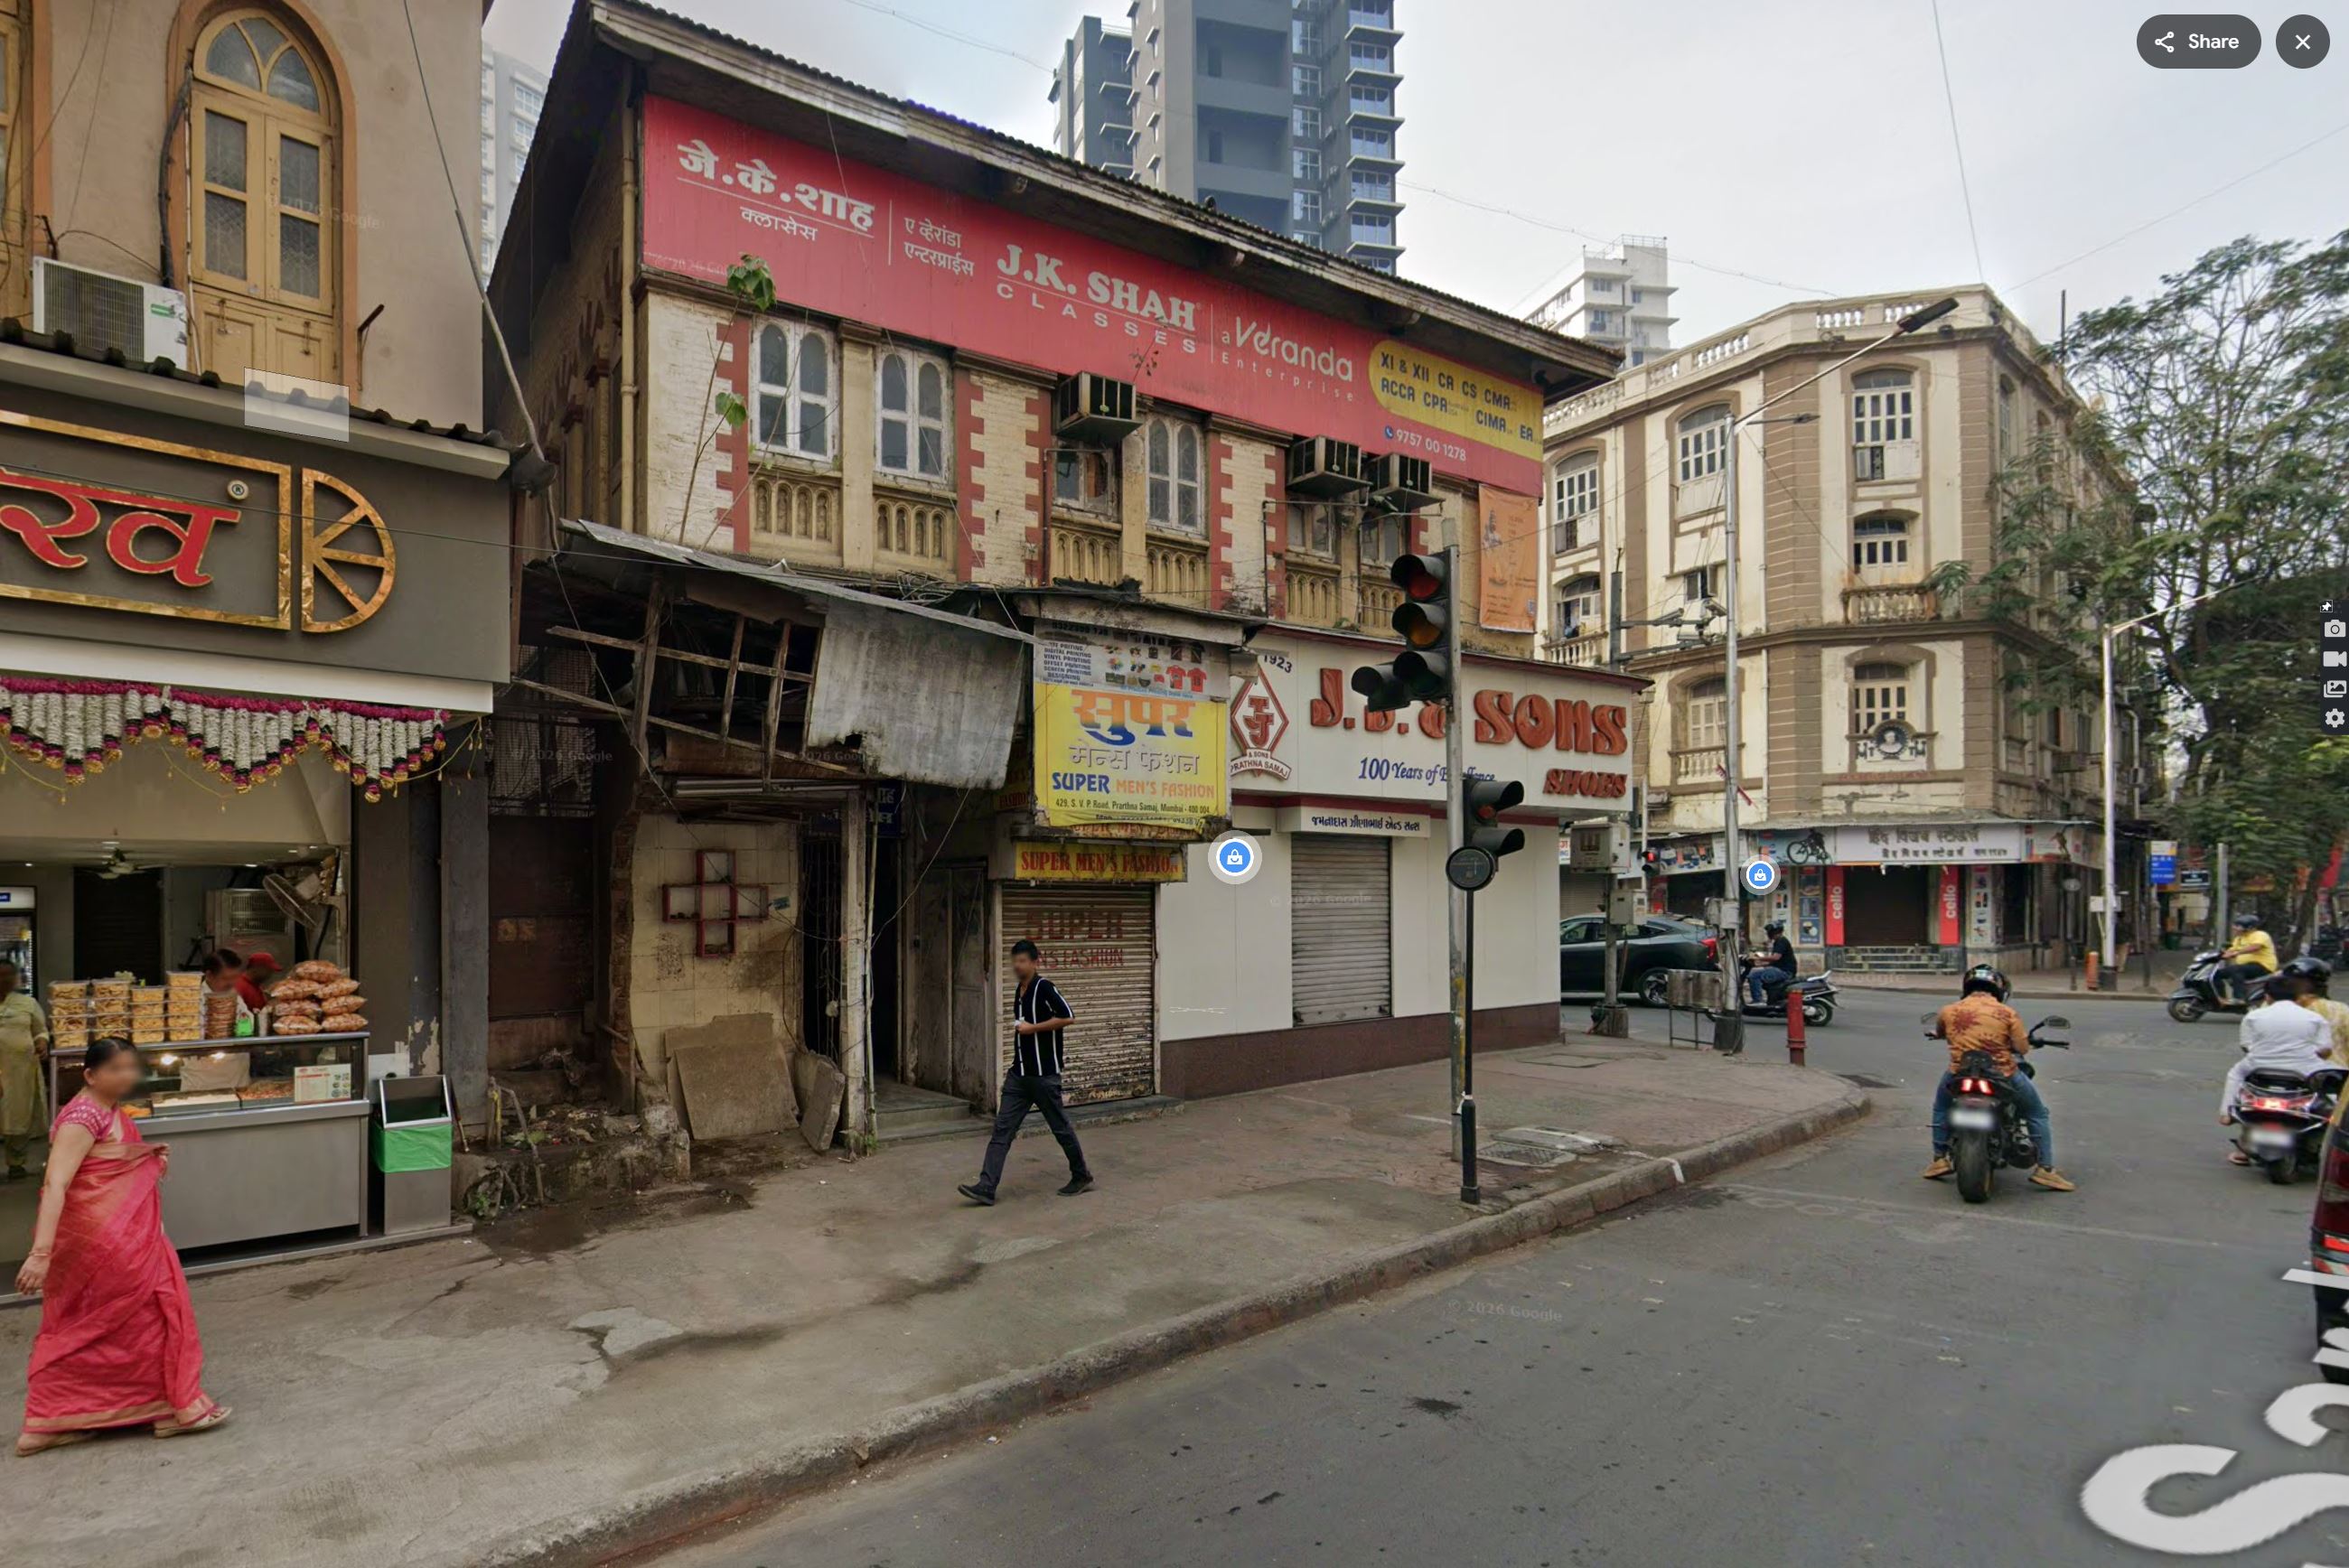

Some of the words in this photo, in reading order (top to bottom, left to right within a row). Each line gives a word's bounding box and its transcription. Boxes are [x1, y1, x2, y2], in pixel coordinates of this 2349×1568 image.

[740, 206, 818, 241] क्लासेस
[904, 217, 915, 234] ए
[997, 244, 1077, 294] J.K.
[1087, 271, 1195, 331] SHAH
[997, 283, 1195, 353] CLASSES
[1222, 329, 1230, 344] a
[1235, 316, 1353, 382] Veranda
[1222, 352, 1353, 402] Enterprise
[1380, 352, 1394, 370] XI
[1399, 359, 1407, 373] &
[1412, 363, 1429, 383] XII
[1462, 381, 1477, 398] CS
[1396, 429, 1422, 447] 9757
[1425, 438, 1440, 453] 00
[1443, 443, 1466, 462] 1278
[1063, 656, 1091, 664] PRINTING
[1066, 649, 1091, 658] PRINTING
[1072, 689, 1196, 746] सुपर
[1052, 771, 1110, 794] SUPER
[1116, 779, 1156, 796] MEN'S
[1162, 782, 1214, 798] FASHION
[1264, 761, 1288, 777] SAMAJ
[1358, 757, 1390, 780] 100
[1391, 761, 1423, 780] Years
[1426, 764, 1440, 786] of
[1543, 768, 1628, 798] SHOES
[1160, 803, 1184, 812] Mumbai
[1021, 851, 1070, 872] SUPER
[1076, 853, 1118, 873] MEN'S
[1830, 886, 1842, 919] cello
[1942, 883, 1956, 919] cello
